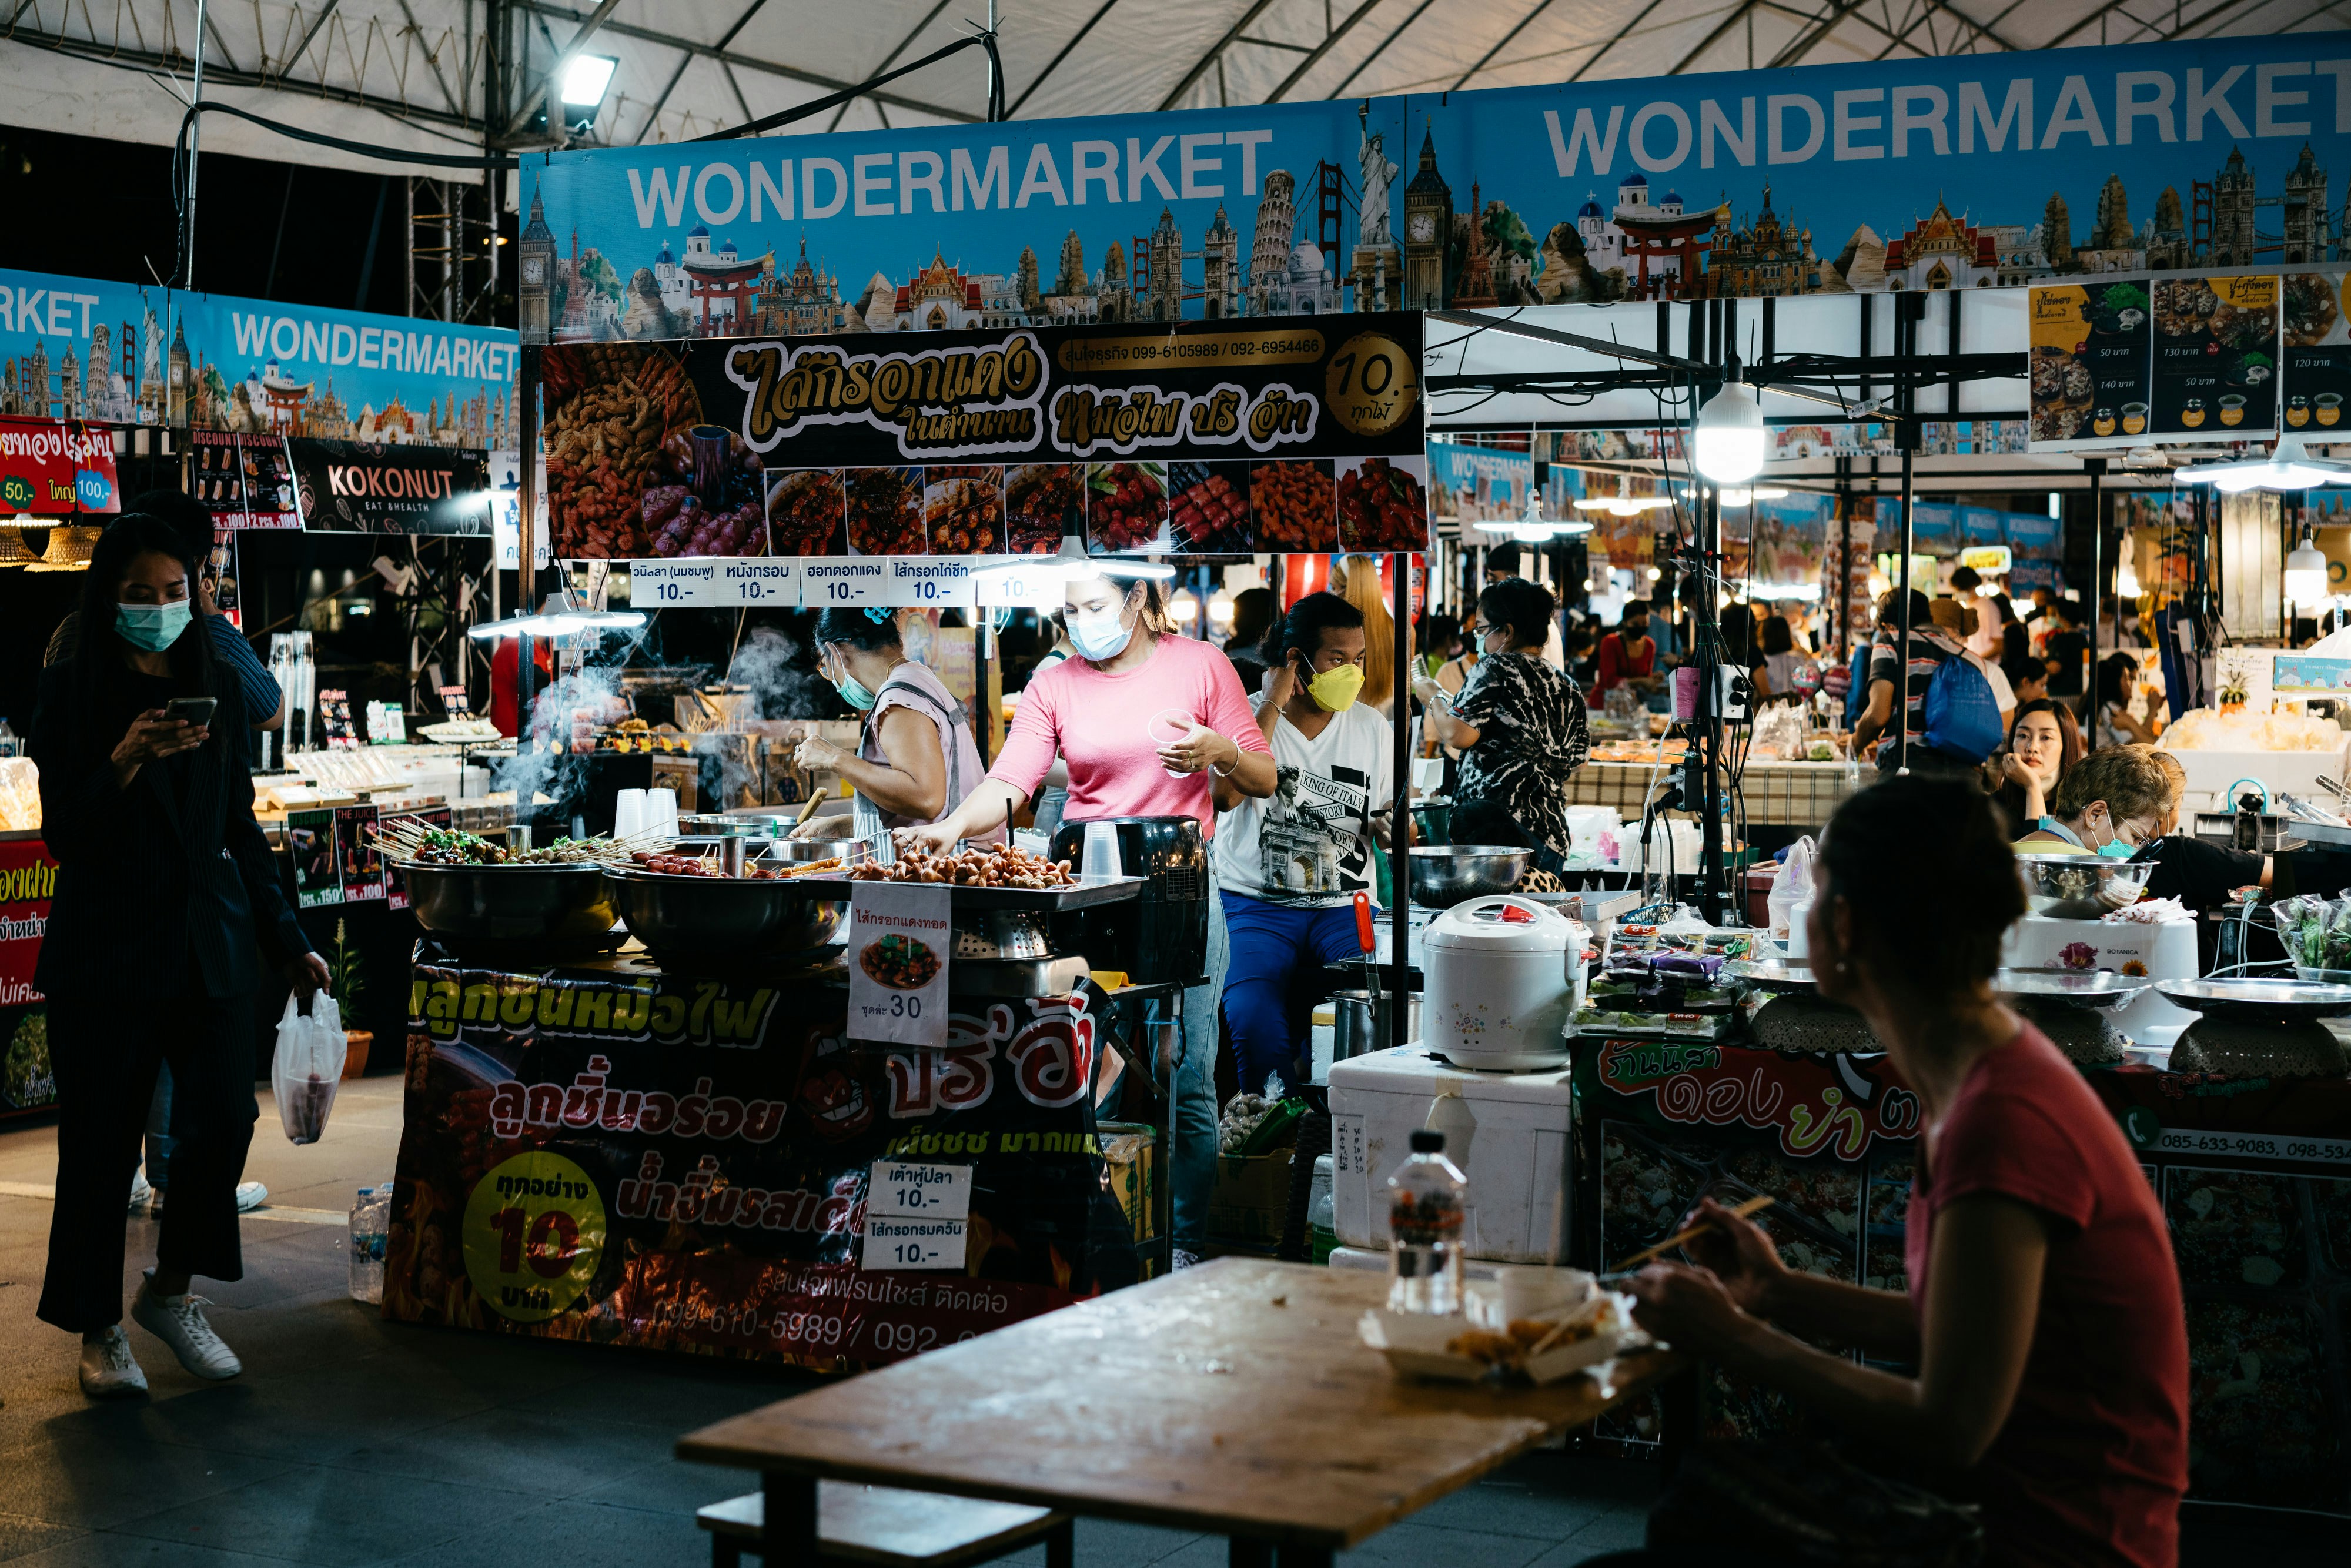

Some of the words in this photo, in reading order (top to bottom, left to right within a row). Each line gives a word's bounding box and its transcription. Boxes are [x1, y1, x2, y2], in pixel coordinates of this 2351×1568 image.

[1543, 59, 2351, 177] WONDERMARKET
[627, 129, 1273, 229] WONDERMARKET
[232, 312, 520, 382] WONDERMARKET
[1132, 343, 1219, 360] 099-6105989
[1230, 338, 1320, 356] 092-6954466
[2099, 349, 2111, 357] 50
[2113, 348, 2129, 356] บาท
[2164, 347, 2181, 356] 130
[2295, 359, 2311, 367] 120
[2313, 358, 2330, 367] บาท
[1333, 353, 1416, 397] 10.-
[2101, 381, 2116, 389] 140
[2185, 377, 2196, 386] 50
[2199, 377, 2215, 386] บาท
[734, 337, 1036, 436] ไส้กรอกแดง
[897, 405, 1031, 442] ในตำนาน
[193, 431, 236, 446] DISCOUNT
[239, 433, 283, 449] DISCOUNT
[78, 479, 110, 500] 100.-
[327, 464, 453, 500] KOKONUT
[365, 501, 383, 511] EAT
[387, 502, 430, 513] &HEALTH
[727, 561, 790, 578] หนังกรอบ
[807, 563, 881, 577] ฮอทดอกแดง
[657, 583, 693, 600] 10.-
[739, 581, 775, 599] 10.-
[827, 581, 864, 599] 10.-
[913, 581, 951, 599] 10.-
[1303, 774, 1325, 793] KING
[1326, 784, 1337, 799] OF
[1337, 788, 1364, 810] ITALY
[337, 809, 352, 820] THE
[354, 808, 376, 818] JUICE
[855, 909, 947, 930] ไส้กรอกแดงทอด
[890, 994, 921, 1018] 30
[491, 1055, 785, 1141] ลูกชิ้นอร่อย
[2162, 1135, 2279, 1156] 085-633-9083,
[496, 1172, 589, 1200] ทุกอย่าง
[889, 1166, 952, 1188] เต้าหู้ปลา
[896, 1188, 940, 1208] 10.-
[871, 1221, 962, 1237] ไส้กรอกรมควัน
[490, 1208, 580, 1279] 10
[894, 1244, 939, 1263] 10.-
[934, 1284, 1008, 1313] ติดต่อ
[651, 1299, 842, 1345] 099-610-5989
